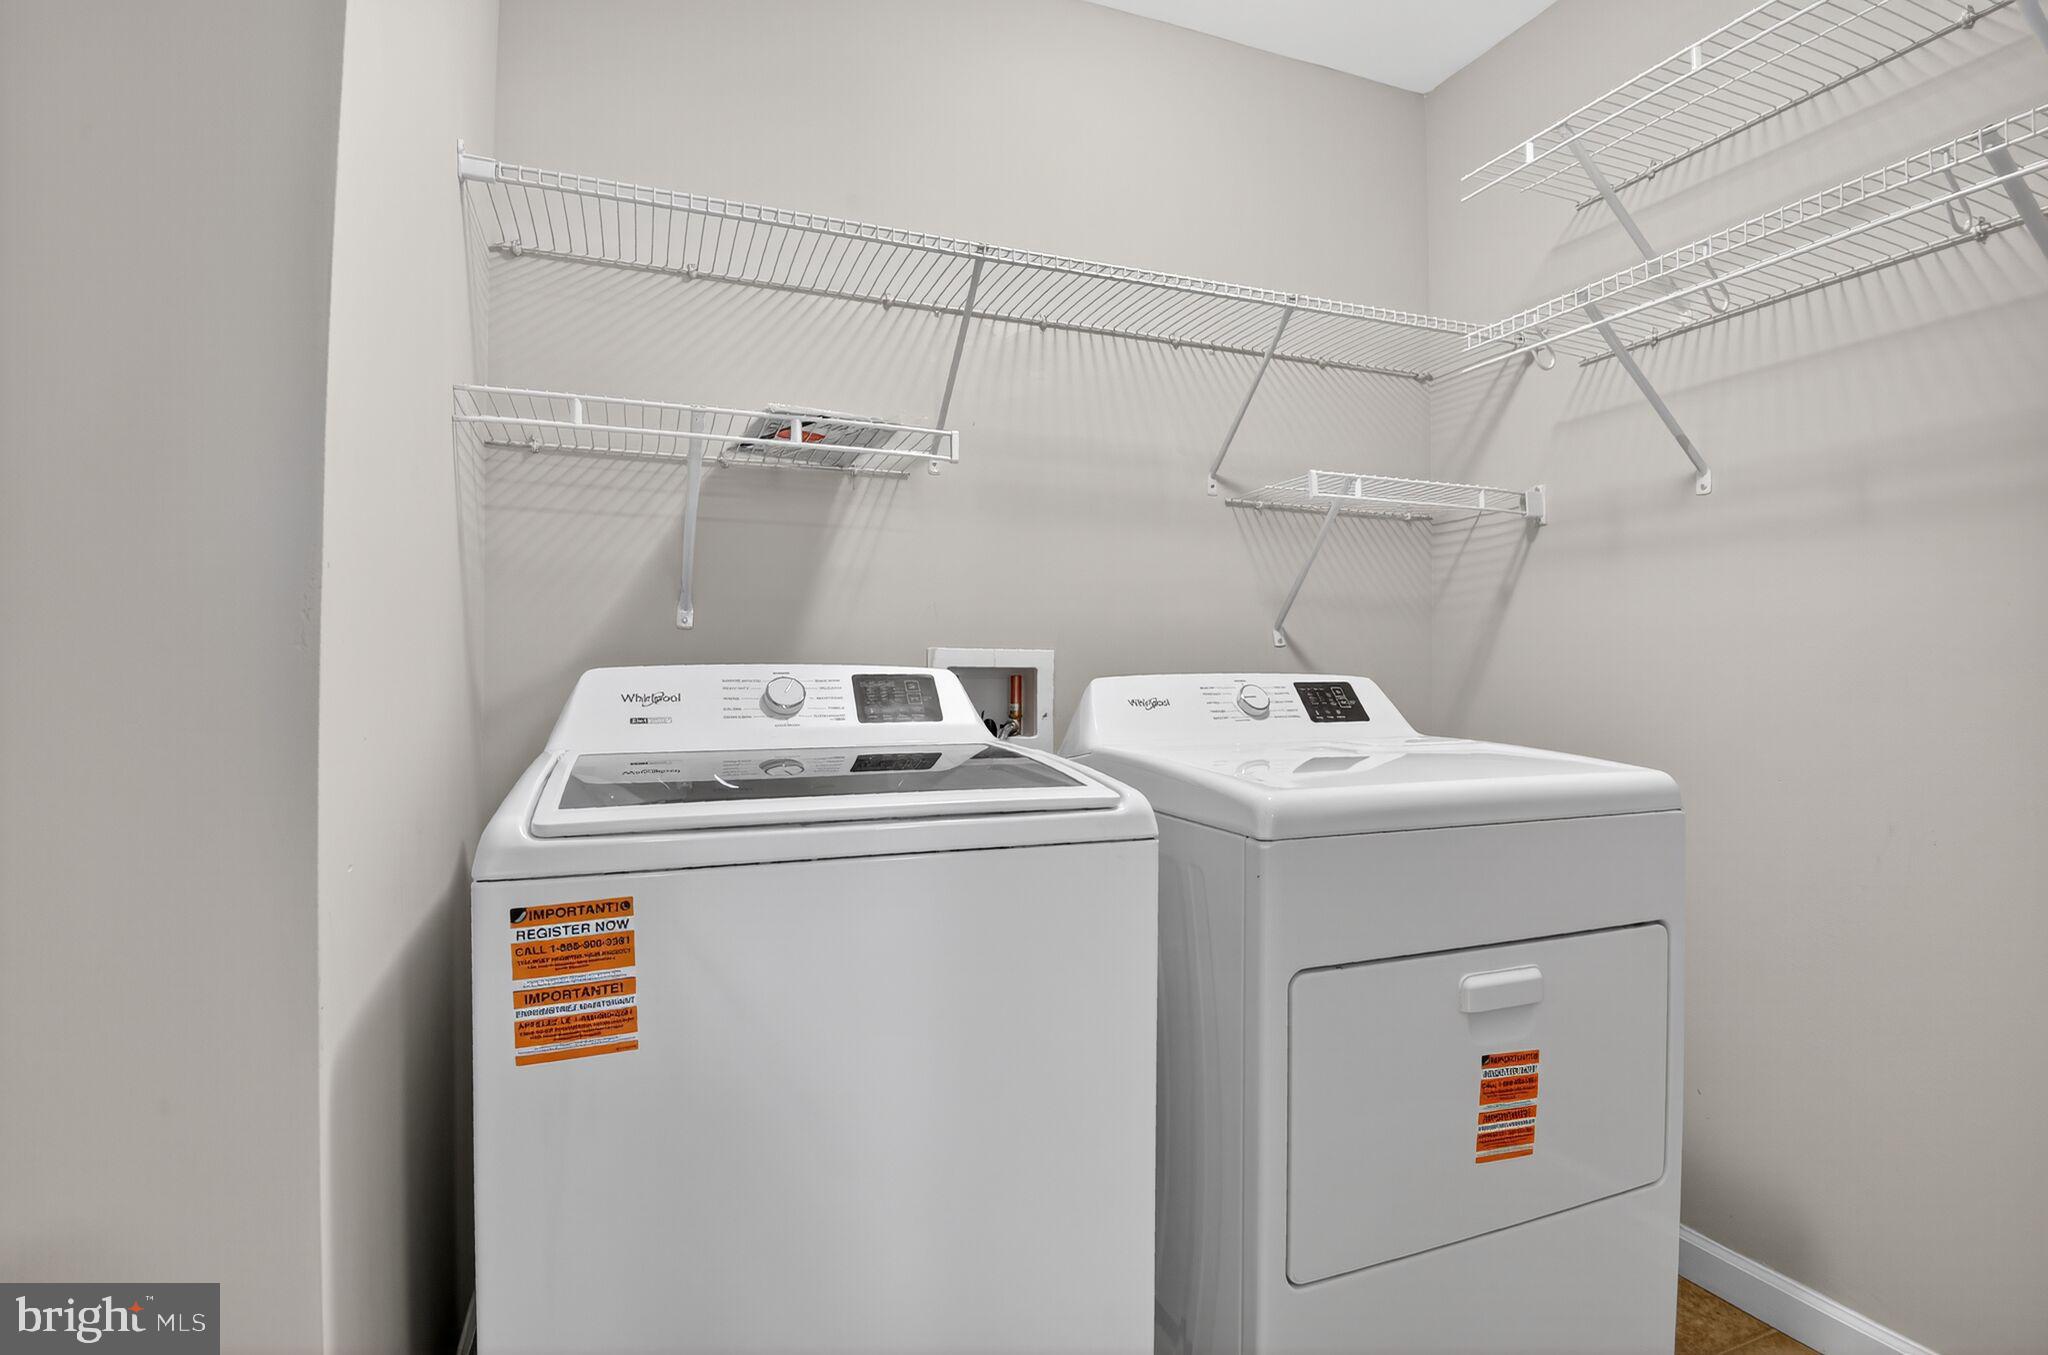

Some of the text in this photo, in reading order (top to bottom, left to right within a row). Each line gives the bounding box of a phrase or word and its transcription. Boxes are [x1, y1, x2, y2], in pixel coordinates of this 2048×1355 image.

[621, 691, 681, 707] Whirlpool
[1127, 697, 1170, 711] Whirlpool
[516, 919, 630, 942] REGISTER NOW
[515, 945, 547, 957] CALL
